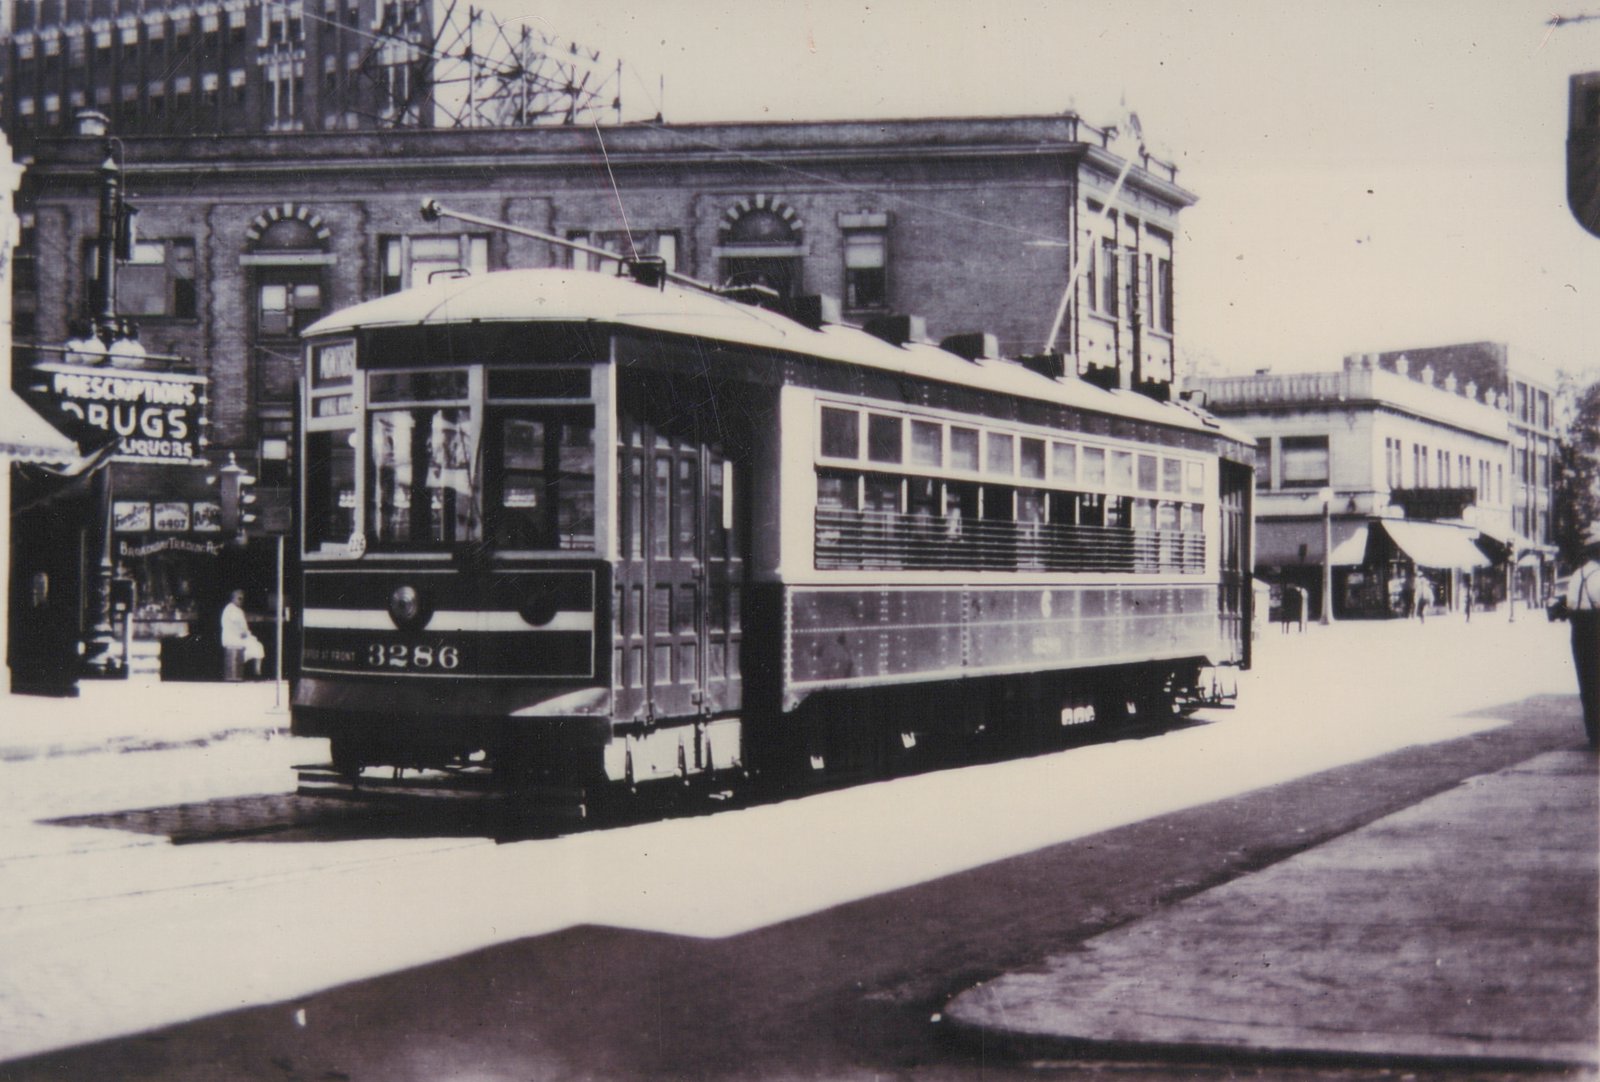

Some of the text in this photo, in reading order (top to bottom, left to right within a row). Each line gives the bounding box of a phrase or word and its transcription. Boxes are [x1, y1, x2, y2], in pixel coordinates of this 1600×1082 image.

[54, 373, 196, 406] PRESCRIPTIONS
[119, 438, 193, 457] LIQUORS
[331, 651, 355, 661] FRONT
[368, 644, 460, 669] 3286
